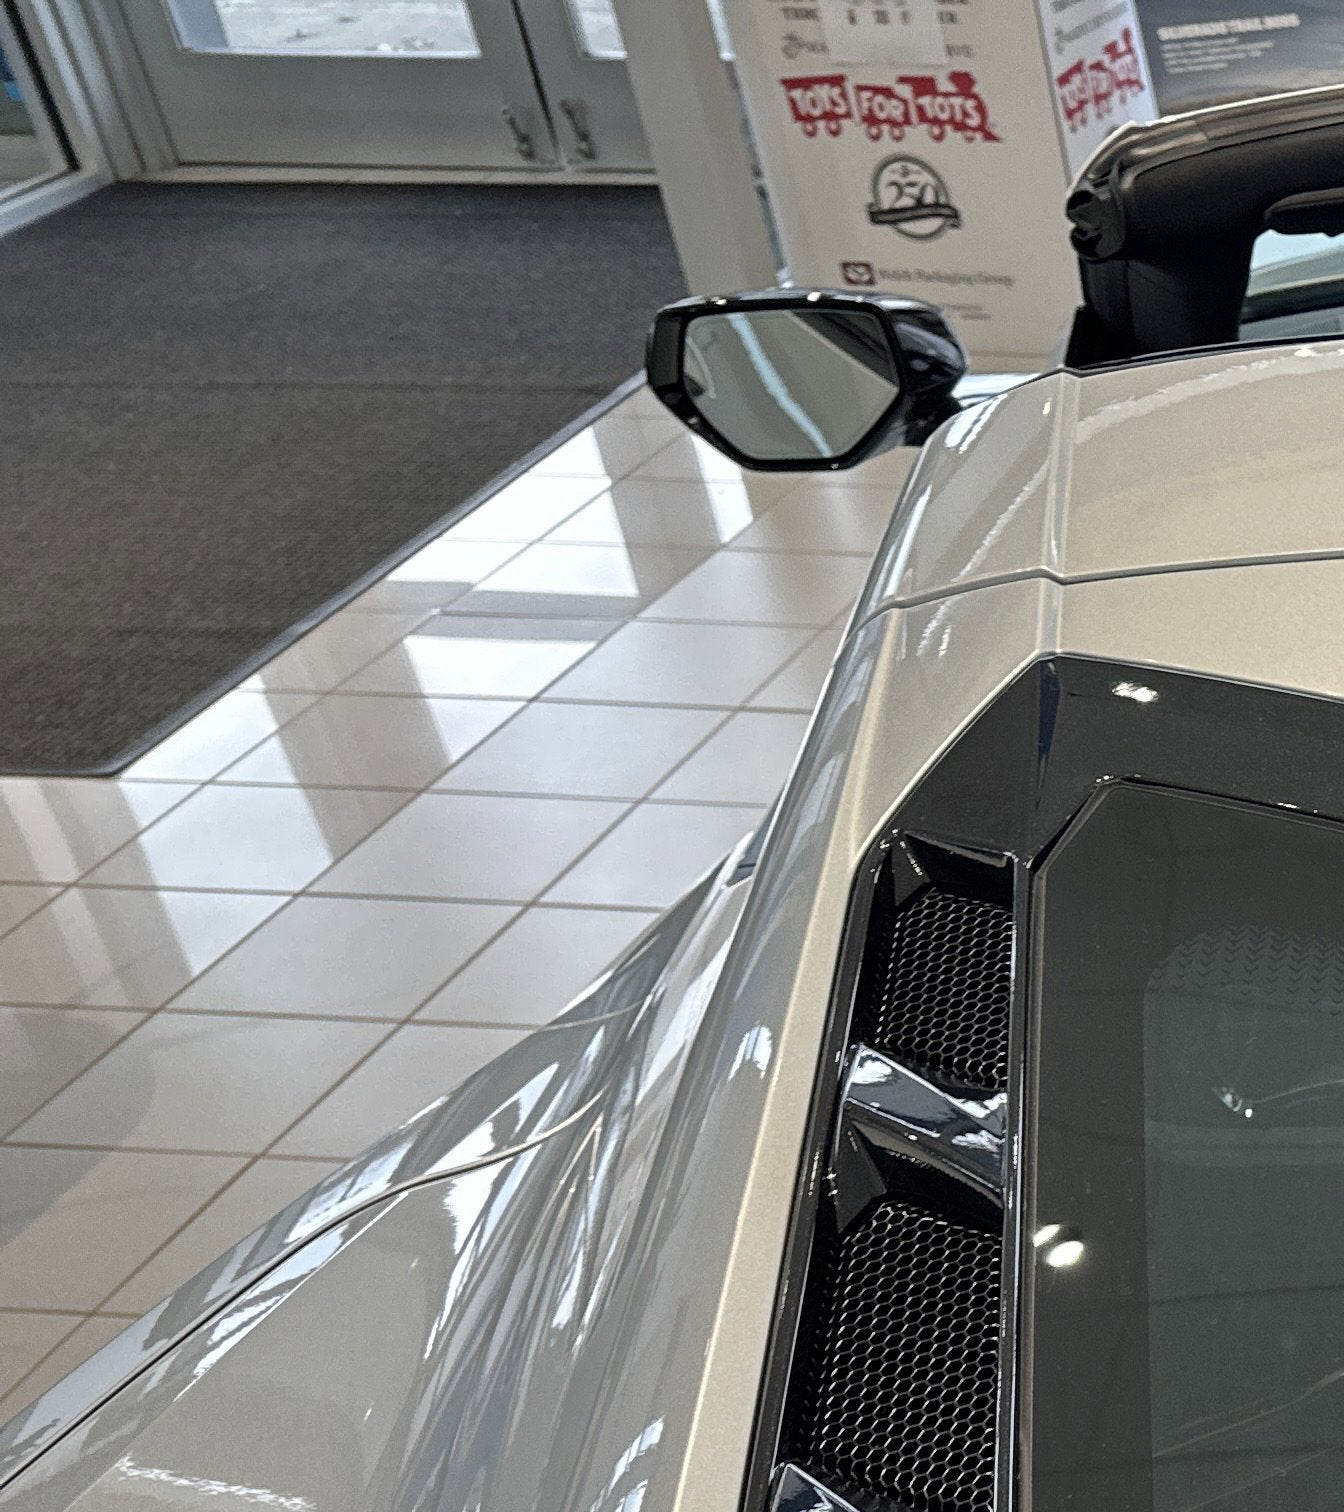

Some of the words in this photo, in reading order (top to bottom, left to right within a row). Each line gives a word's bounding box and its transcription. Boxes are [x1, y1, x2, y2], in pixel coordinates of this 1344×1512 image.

[1157, 22, 1228, 41] SILVERADO
[1229, 18, 1262, 34] TRAIL
[788, 83, 849, 117] TOYS
[859, 91, 905, 121] FOR
[915, 96, 982, 127] TOTS
[886, 181, 940, 208] 250
